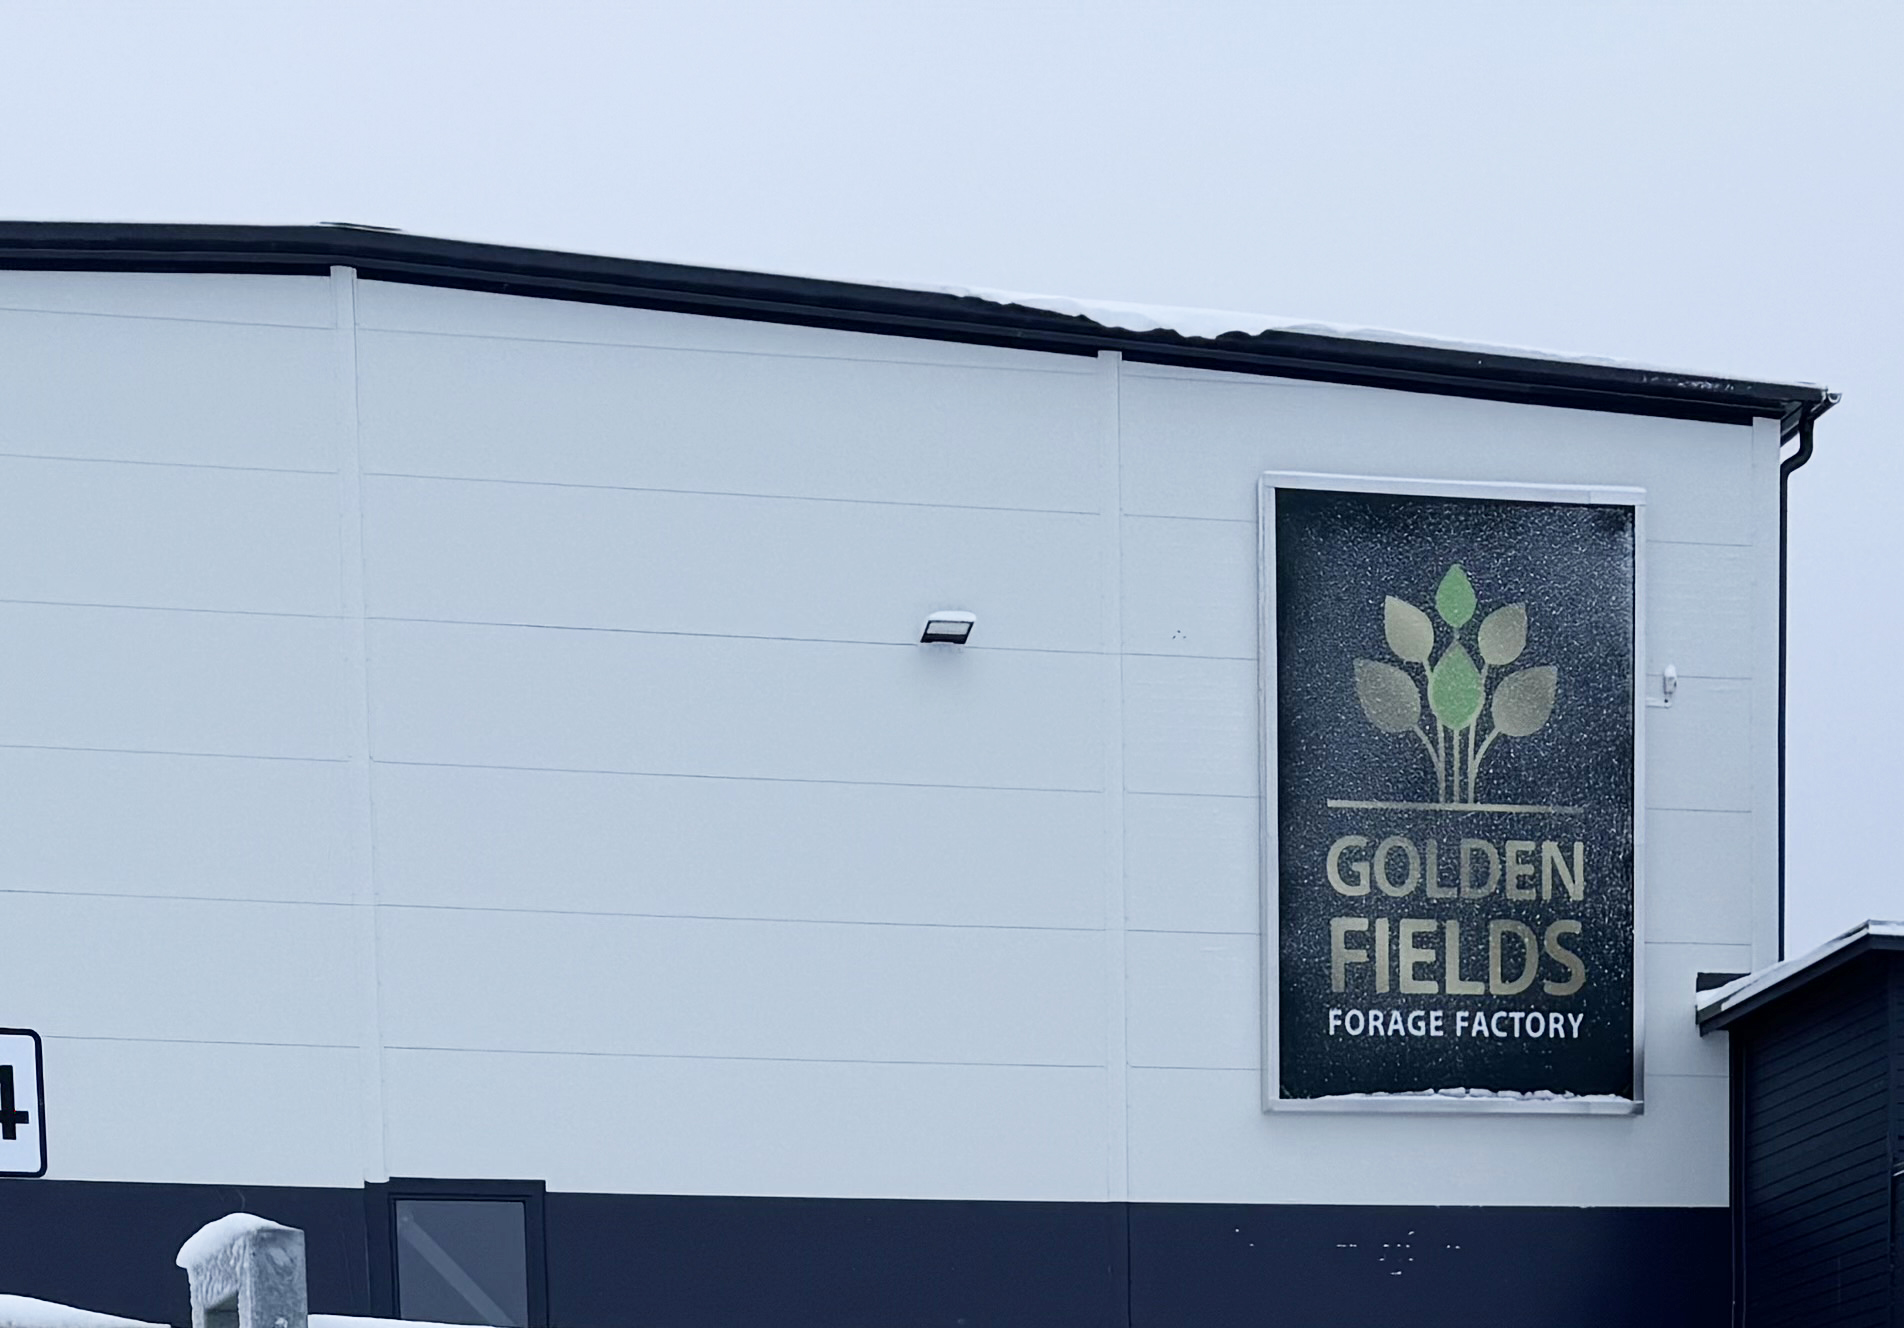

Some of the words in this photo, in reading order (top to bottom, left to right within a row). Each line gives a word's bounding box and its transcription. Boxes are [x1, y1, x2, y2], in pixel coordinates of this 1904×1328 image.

[1326, 835, 1585, 901] GOLDEN
[1329, 916, 1587, 996] FIELDS
[1328, 1008, 1444, 1037] FORAGE
[1455, 1011, 1585, 1039] FACTORY
